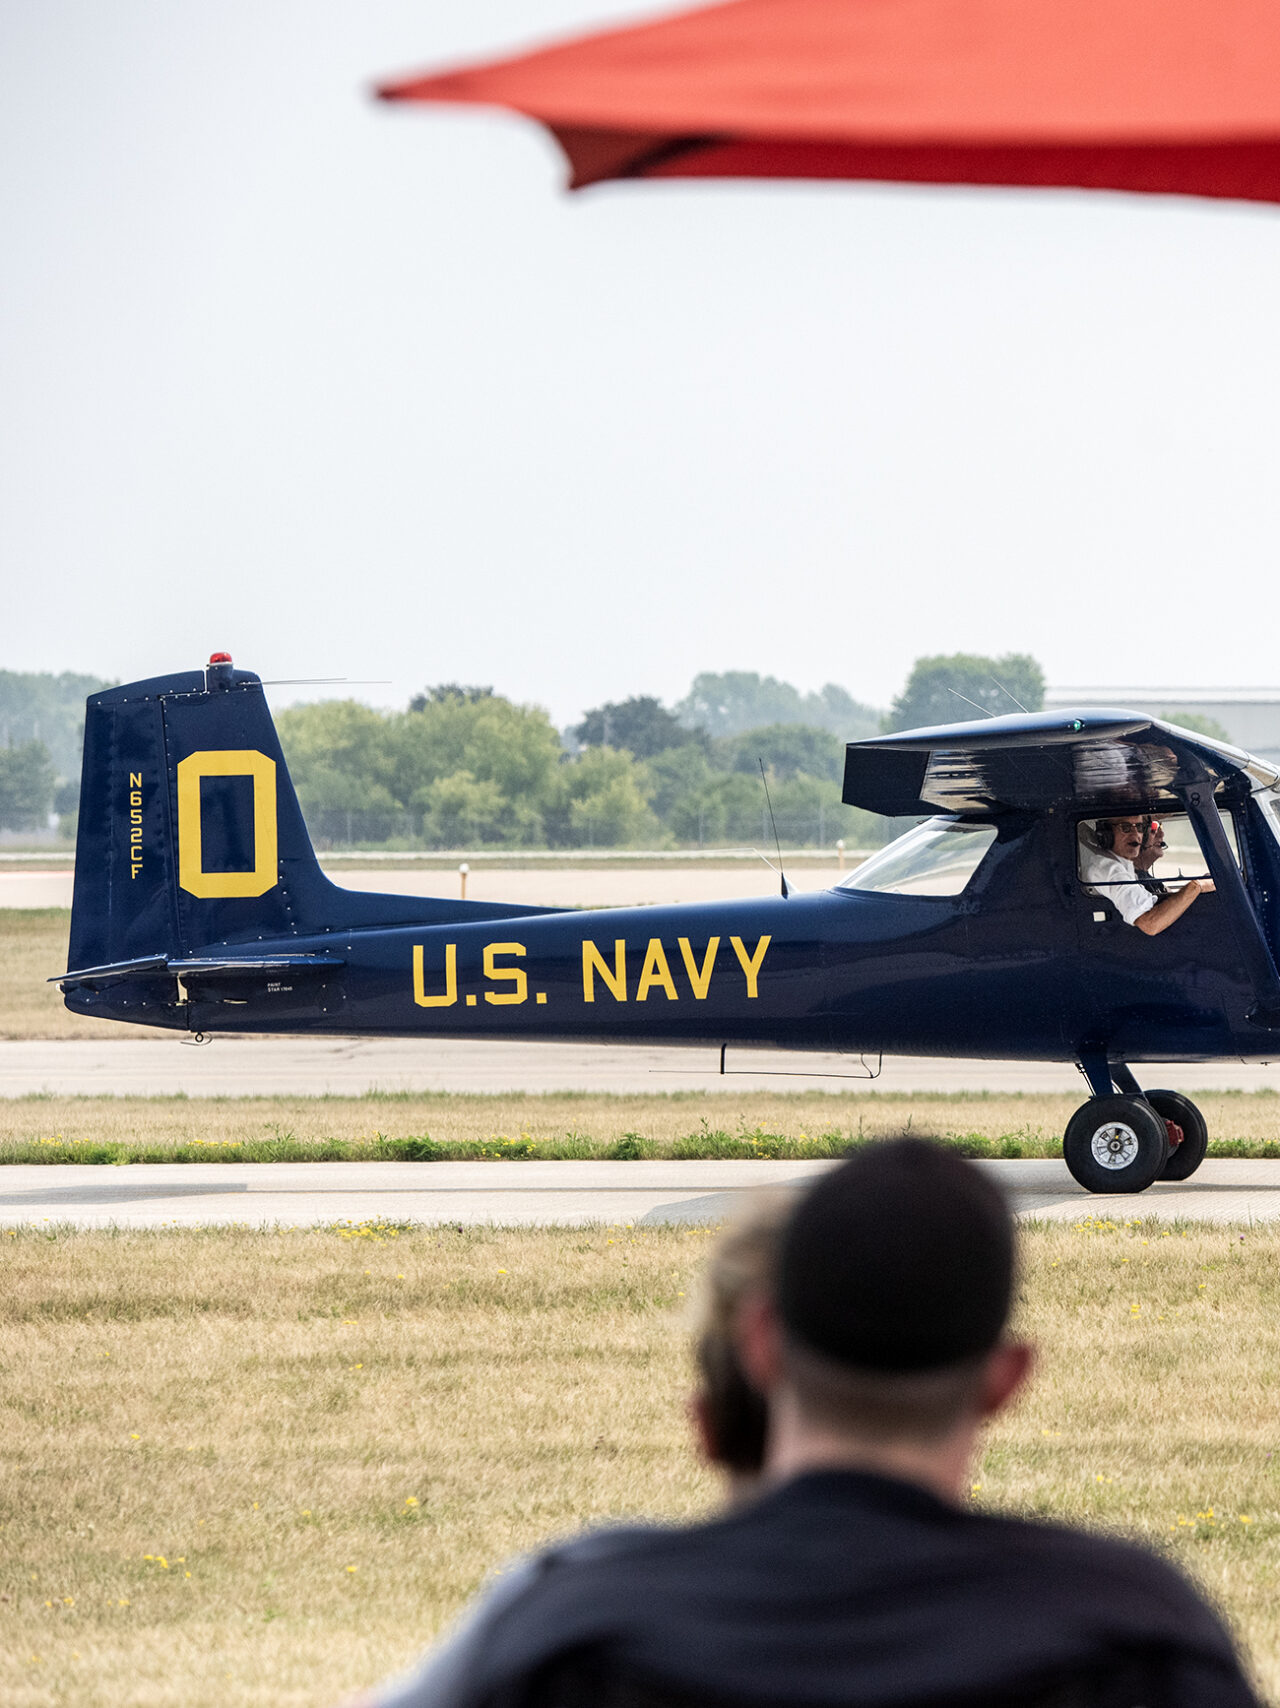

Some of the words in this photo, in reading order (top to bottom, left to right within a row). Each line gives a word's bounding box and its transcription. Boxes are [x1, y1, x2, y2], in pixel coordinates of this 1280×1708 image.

[129, 772, 144, 879] N652CF
[412, 942, 548, 1008] U.S.
[582, 935, 772, 1003] NAVY
